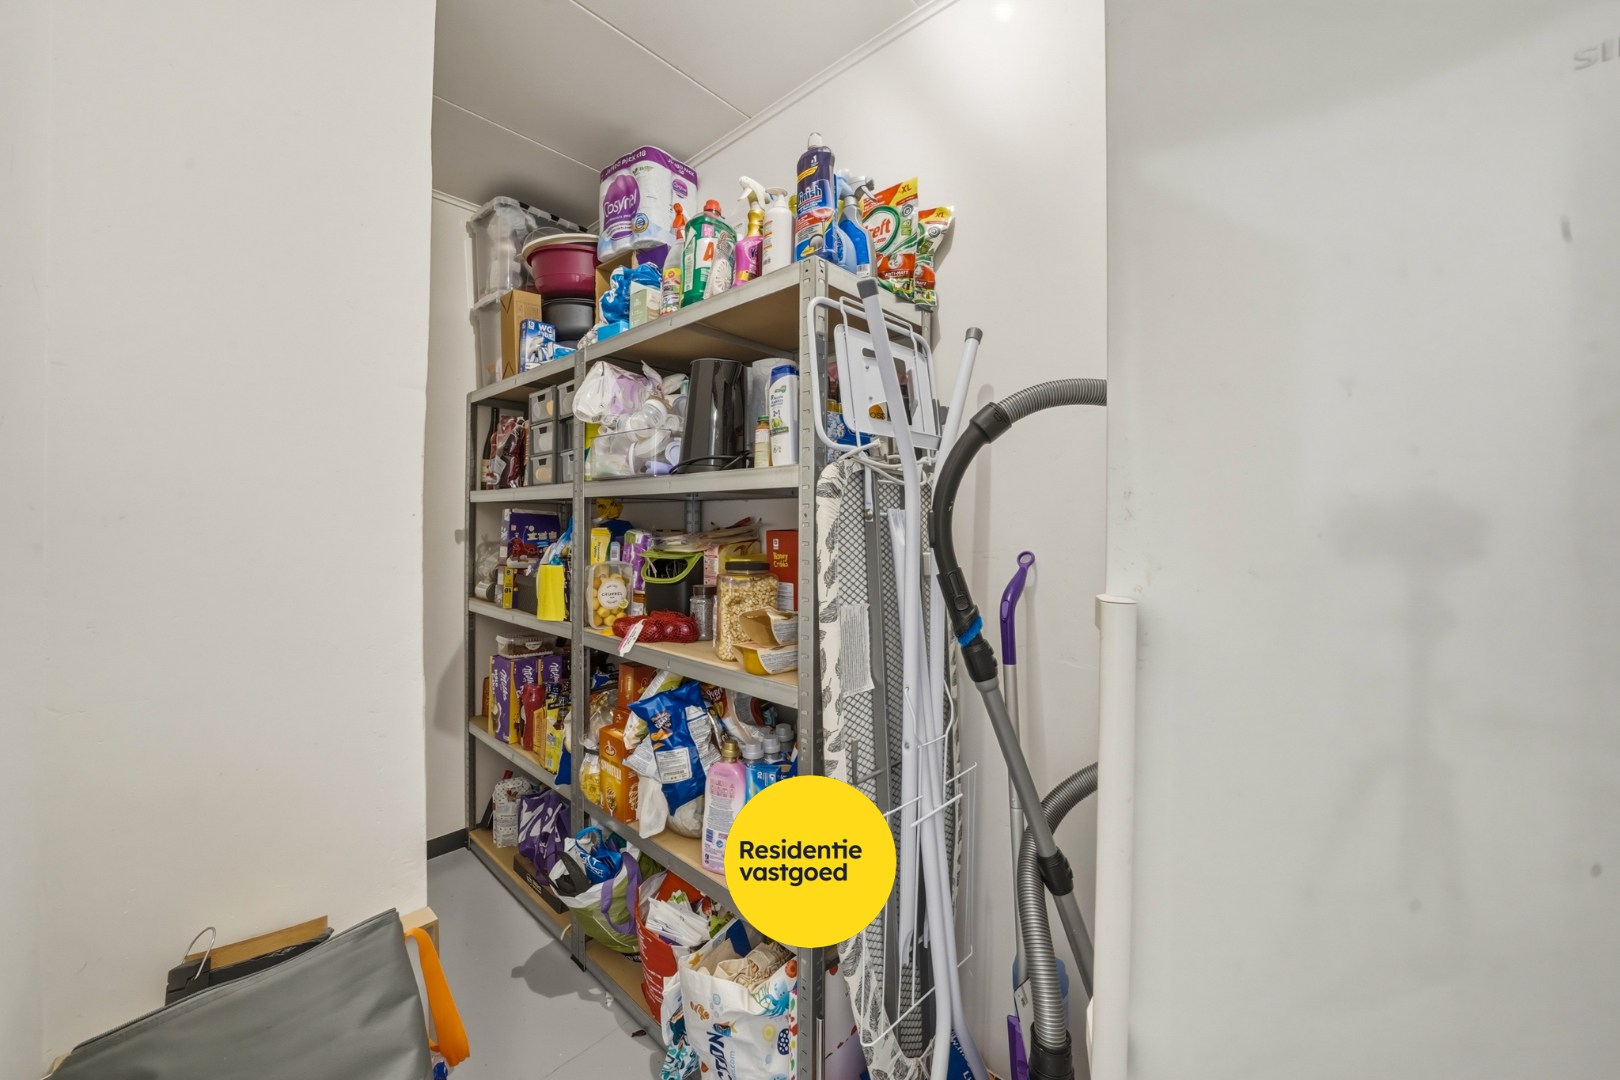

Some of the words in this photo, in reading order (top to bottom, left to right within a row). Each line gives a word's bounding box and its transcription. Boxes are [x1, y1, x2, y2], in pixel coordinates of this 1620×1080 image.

[1573, 36, 1620, 71] SI
[901, 184, 912, 194] XL
[864, 217, 892, 239] reft
[521, 664, 534, 684] Milk
[706, 1030, 732, 1080] CTION
